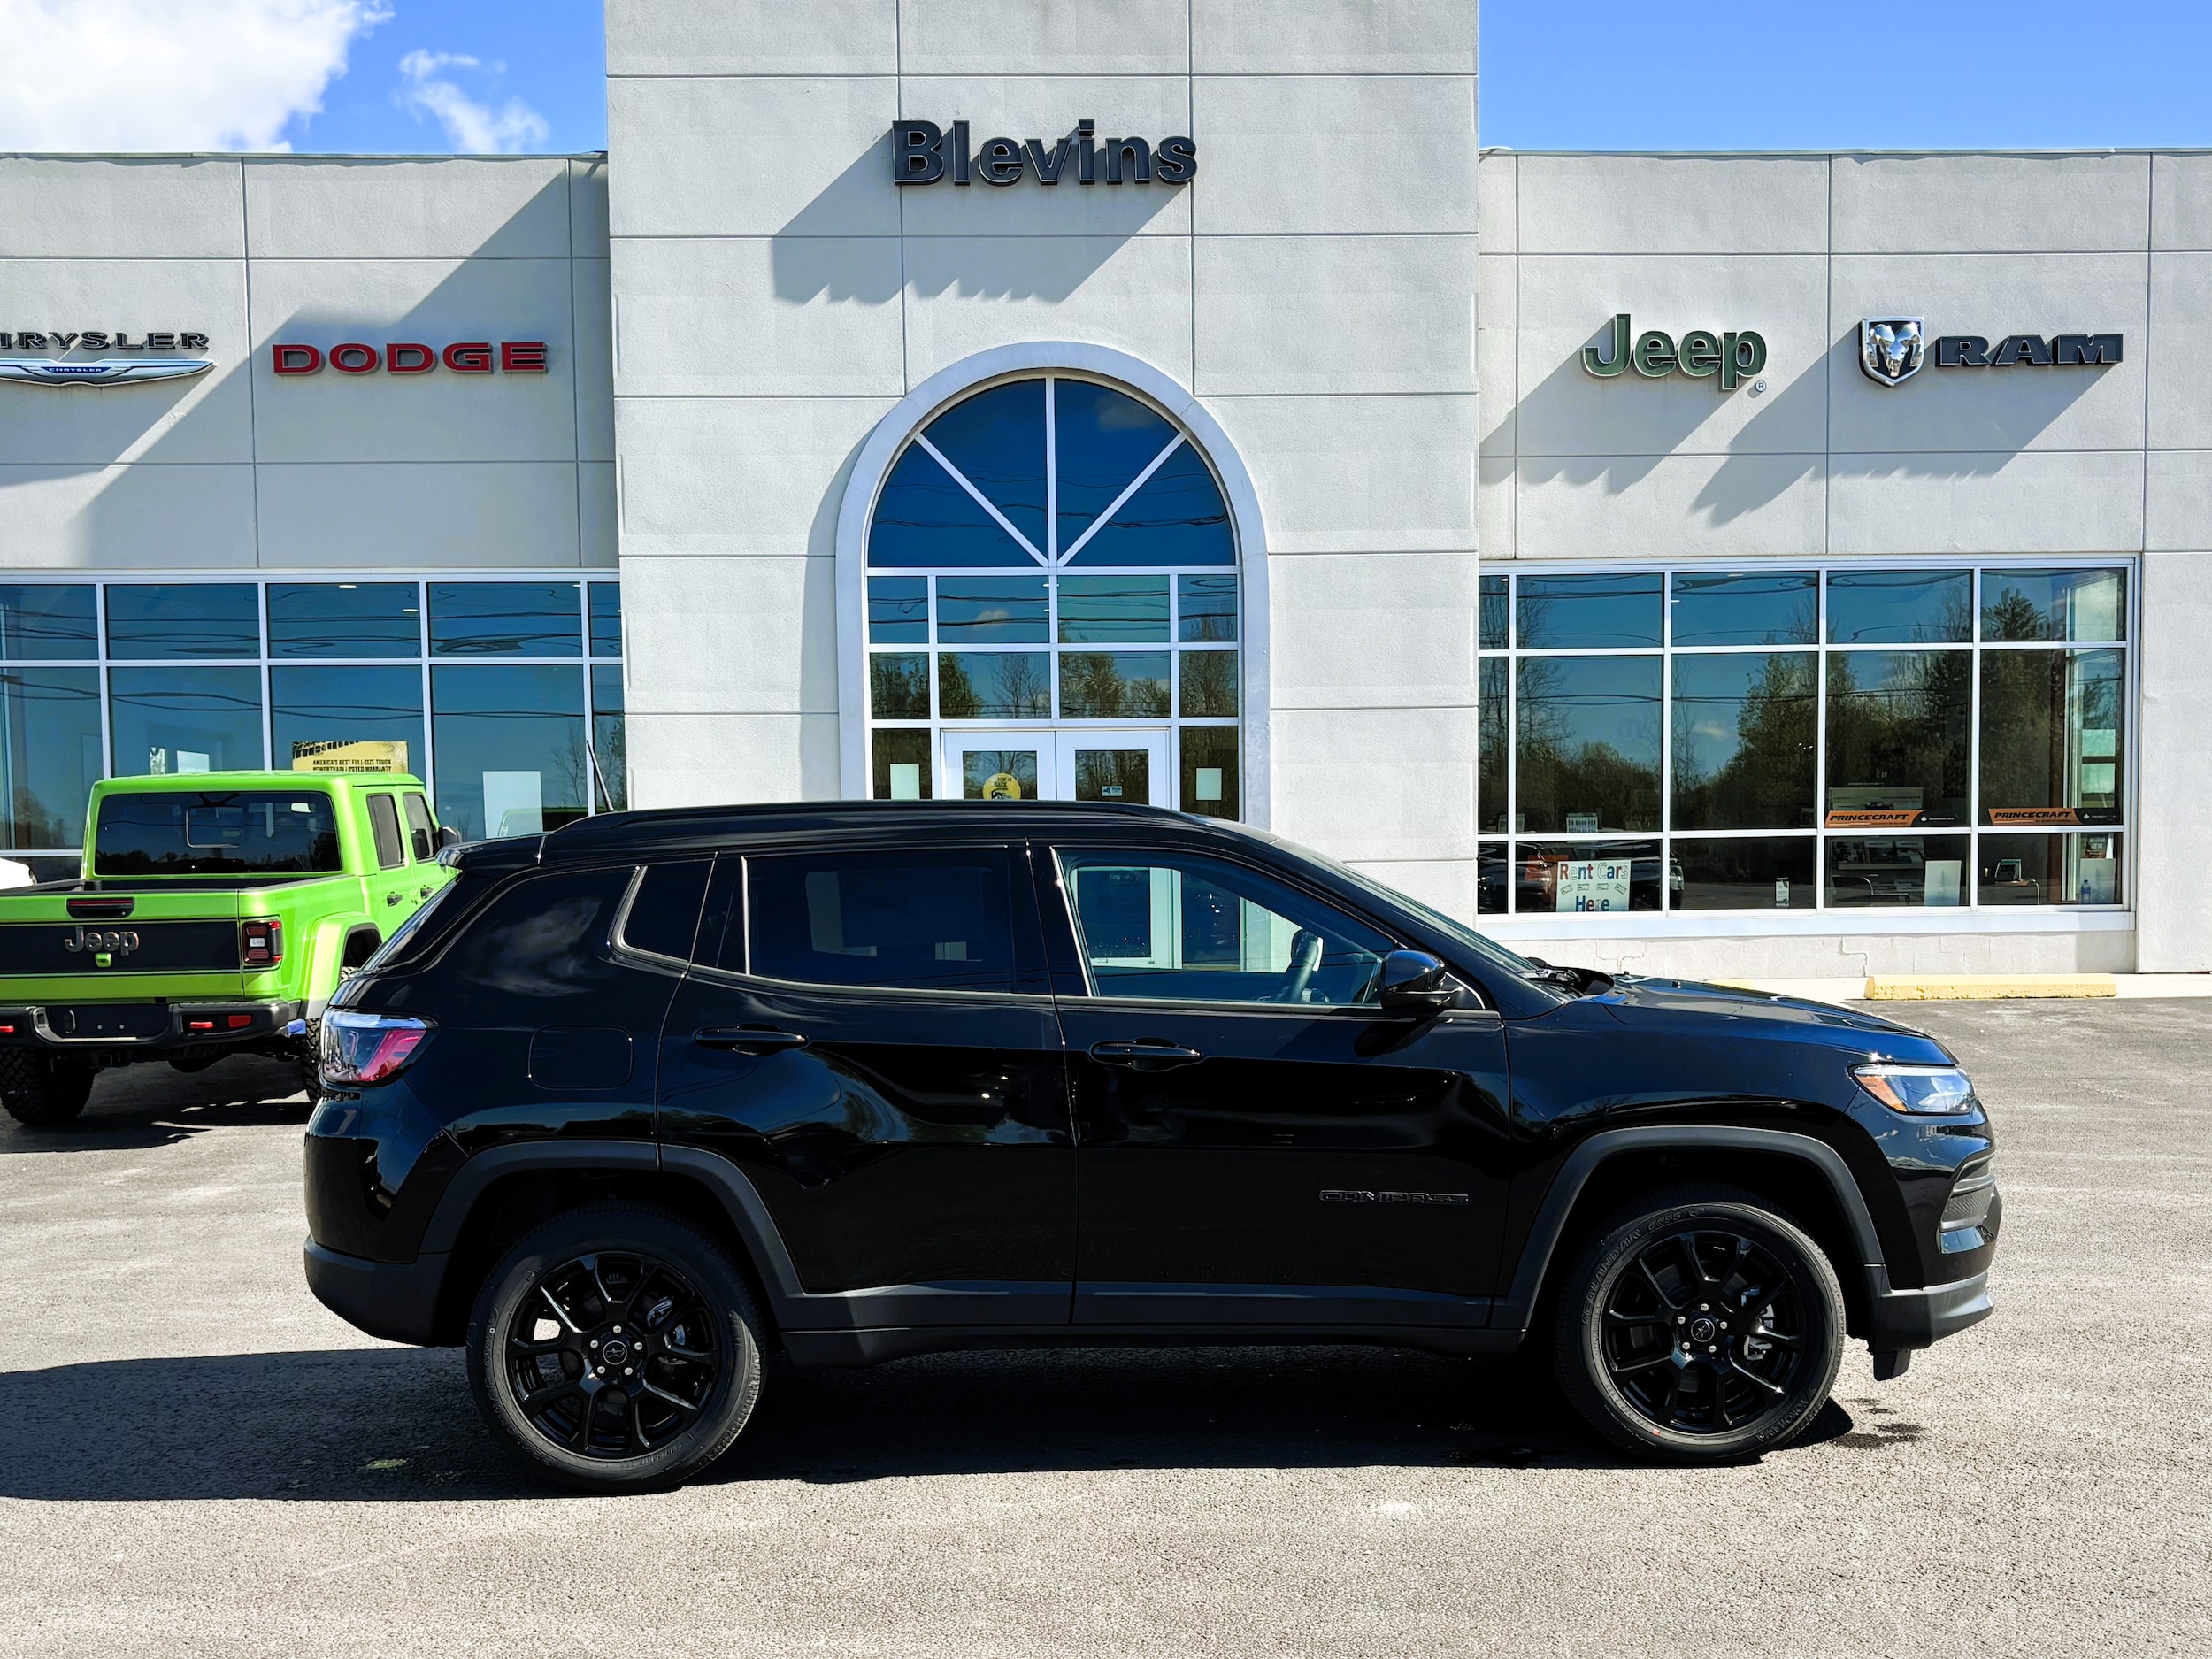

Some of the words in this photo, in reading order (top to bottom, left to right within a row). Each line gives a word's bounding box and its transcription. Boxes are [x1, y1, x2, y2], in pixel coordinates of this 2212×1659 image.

[892, 119, 1197, 185] Blevins
[273, 342, 547, 374] DODGE
[1582, 314, 1767, 390] Jeep
[1935, 334, 2124, 367] RAM
[1560, 863, 1594, 880] Rent
[1597, 862, 1628, 879] Cars
[1575, 895, 1610, 912] Here
[64, 926, 139, 956] Jeep
